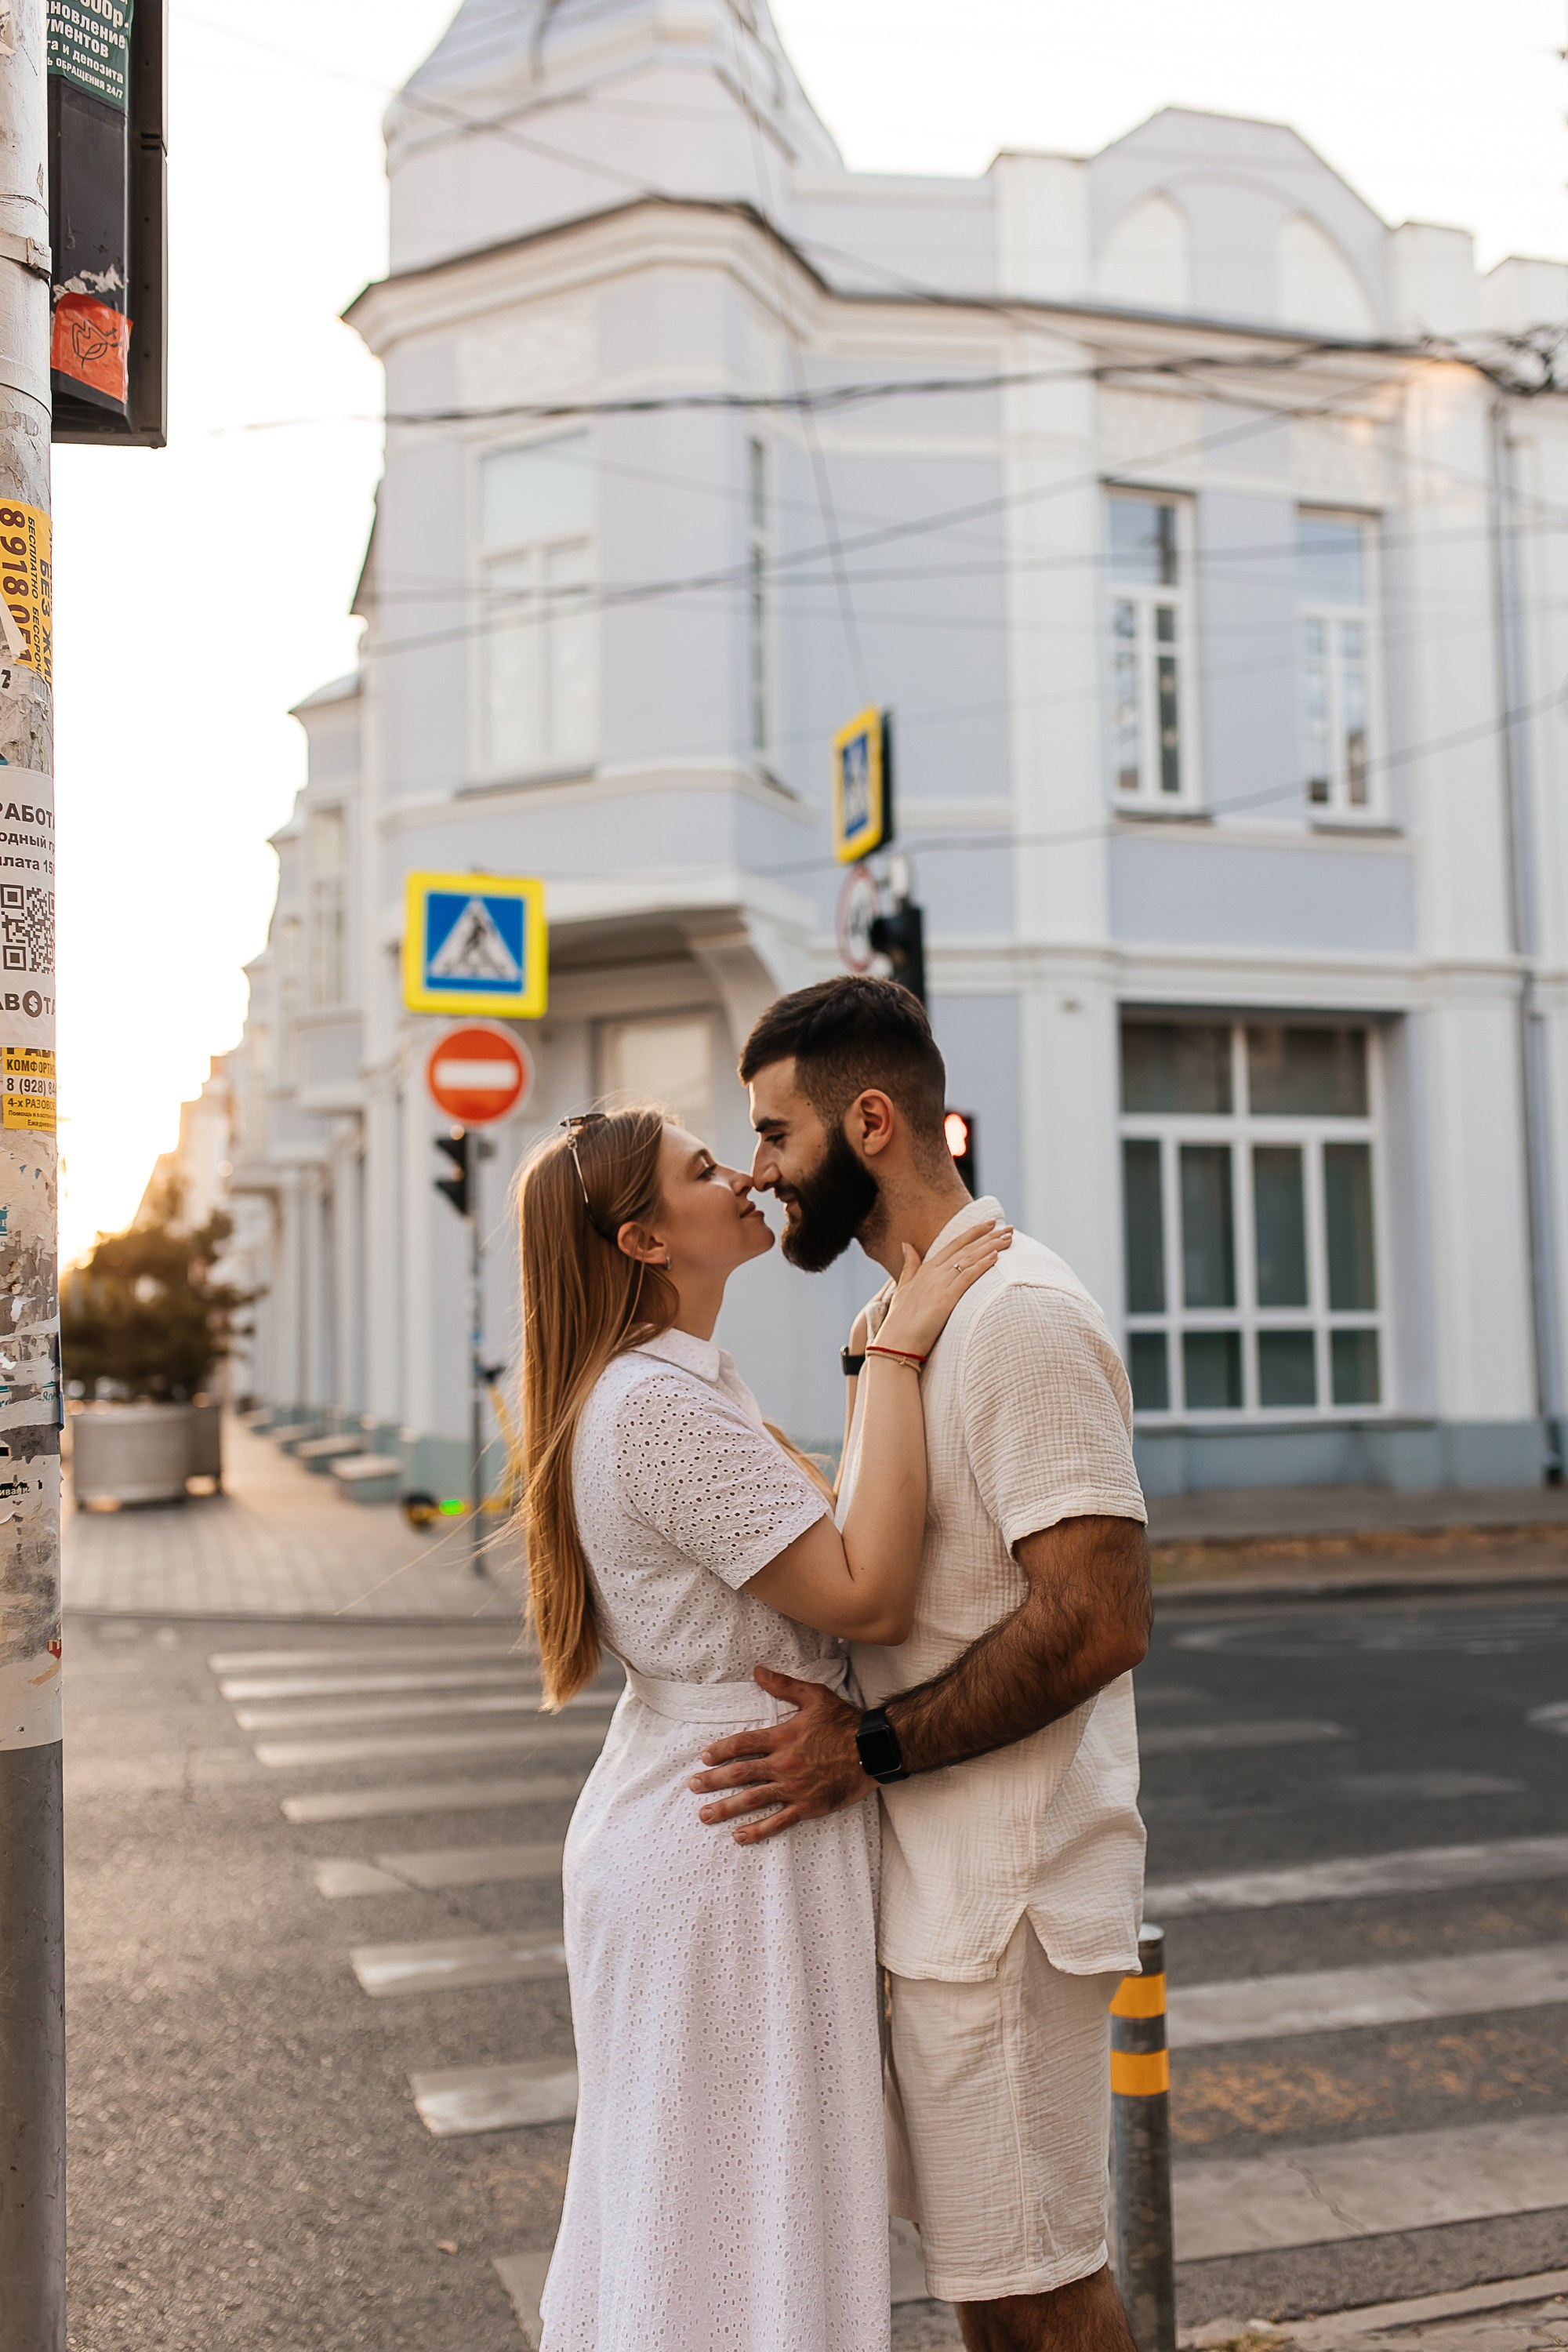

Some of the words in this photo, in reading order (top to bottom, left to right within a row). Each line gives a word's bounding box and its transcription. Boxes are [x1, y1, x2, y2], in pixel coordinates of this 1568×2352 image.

[56, 57, 105, 90] ОБРАЩЕНИЯ
[106, 84, 124, 100] 24/7
[62, 43, 70, 56] и
[72, 49, 124, 84] депозита
[0, 508, 25, 528] 8
[0, 536, 29, 596] 918
[27, 516, 38, 600] БЕСПЛАТНО
[40, 559, 51, 617] БЕЗ
[32, 606, 42, 676] БЕССРОЧ
[0, 856, 40, 871] лата
[43, 859, 55, 876] 15
[6, 1078, 14, 1091] 8
[19, 1078, 46, 1097] (928)
[8, 1098, 24, 1108] 4-х
